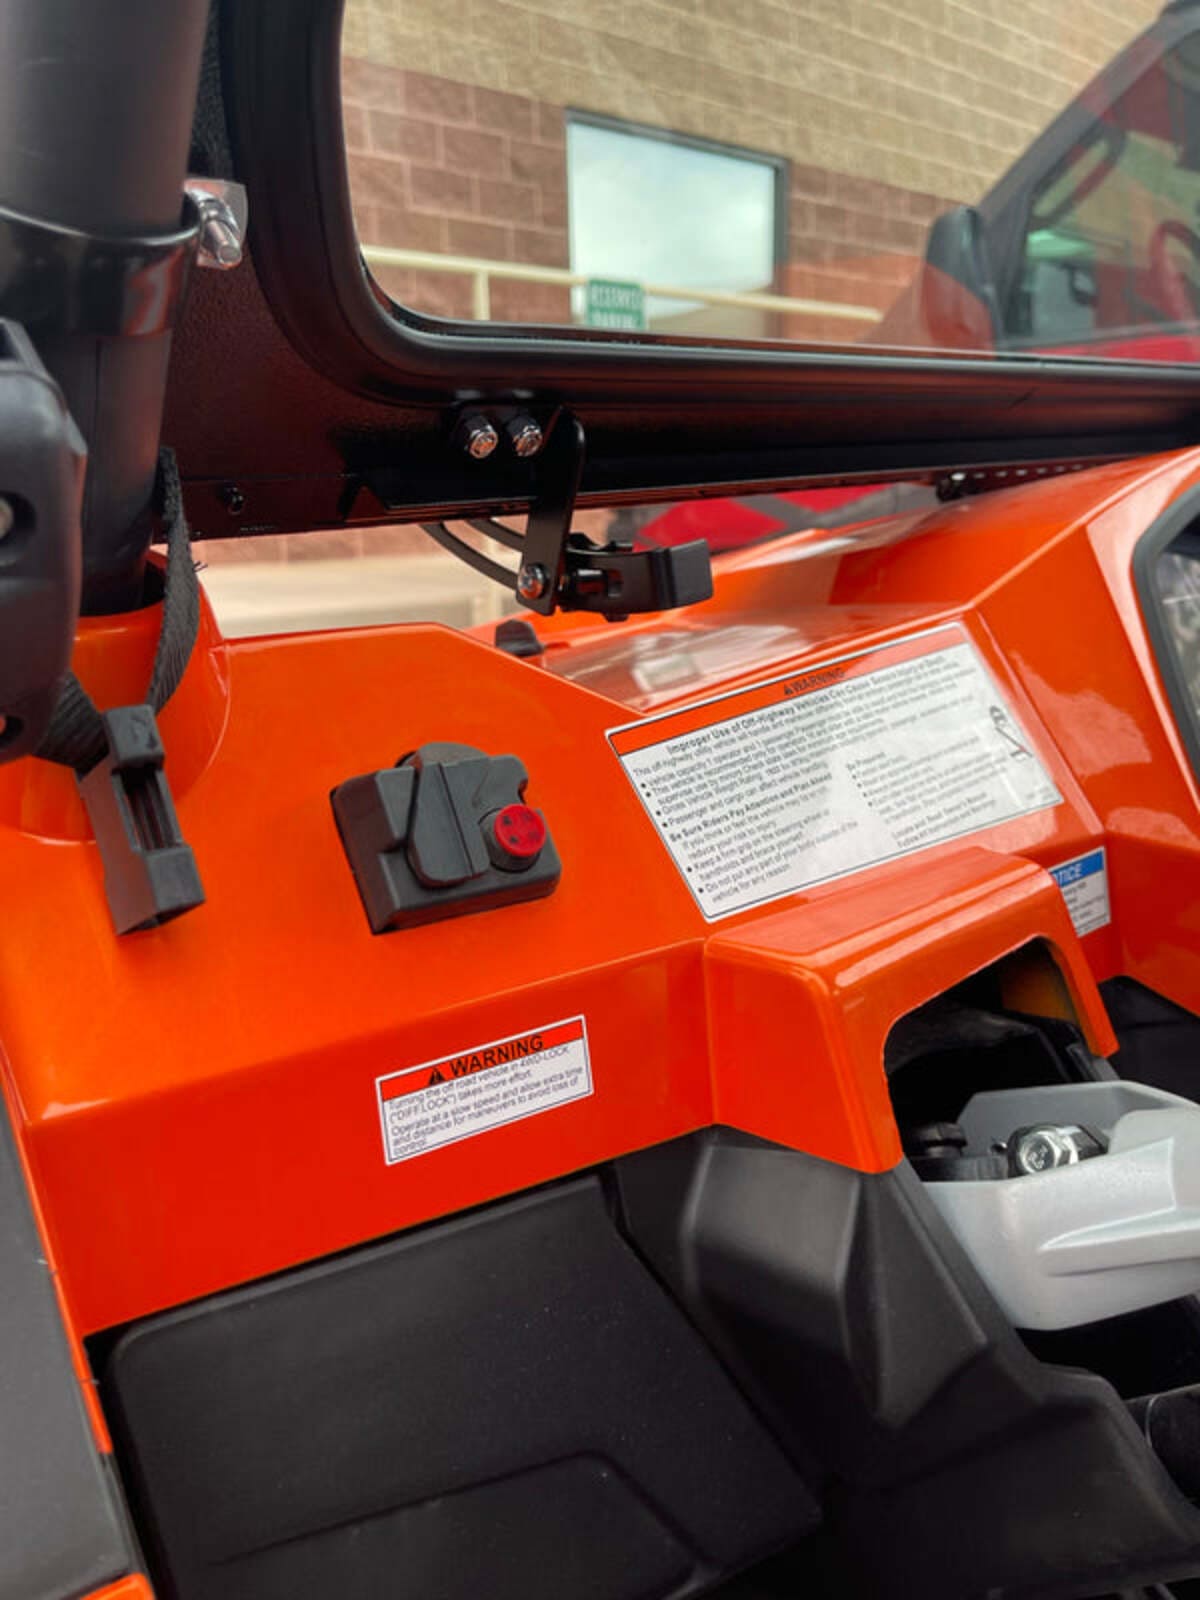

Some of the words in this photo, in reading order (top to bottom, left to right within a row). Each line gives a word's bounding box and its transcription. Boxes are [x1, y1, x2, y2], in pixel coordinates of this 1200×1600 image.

[789, 666, 846, 692] WARNING
[665, 732, 714, 756] Improper
[710, 726, 731, 739] Use
[449, 1034, 544, 1077] WARNING
